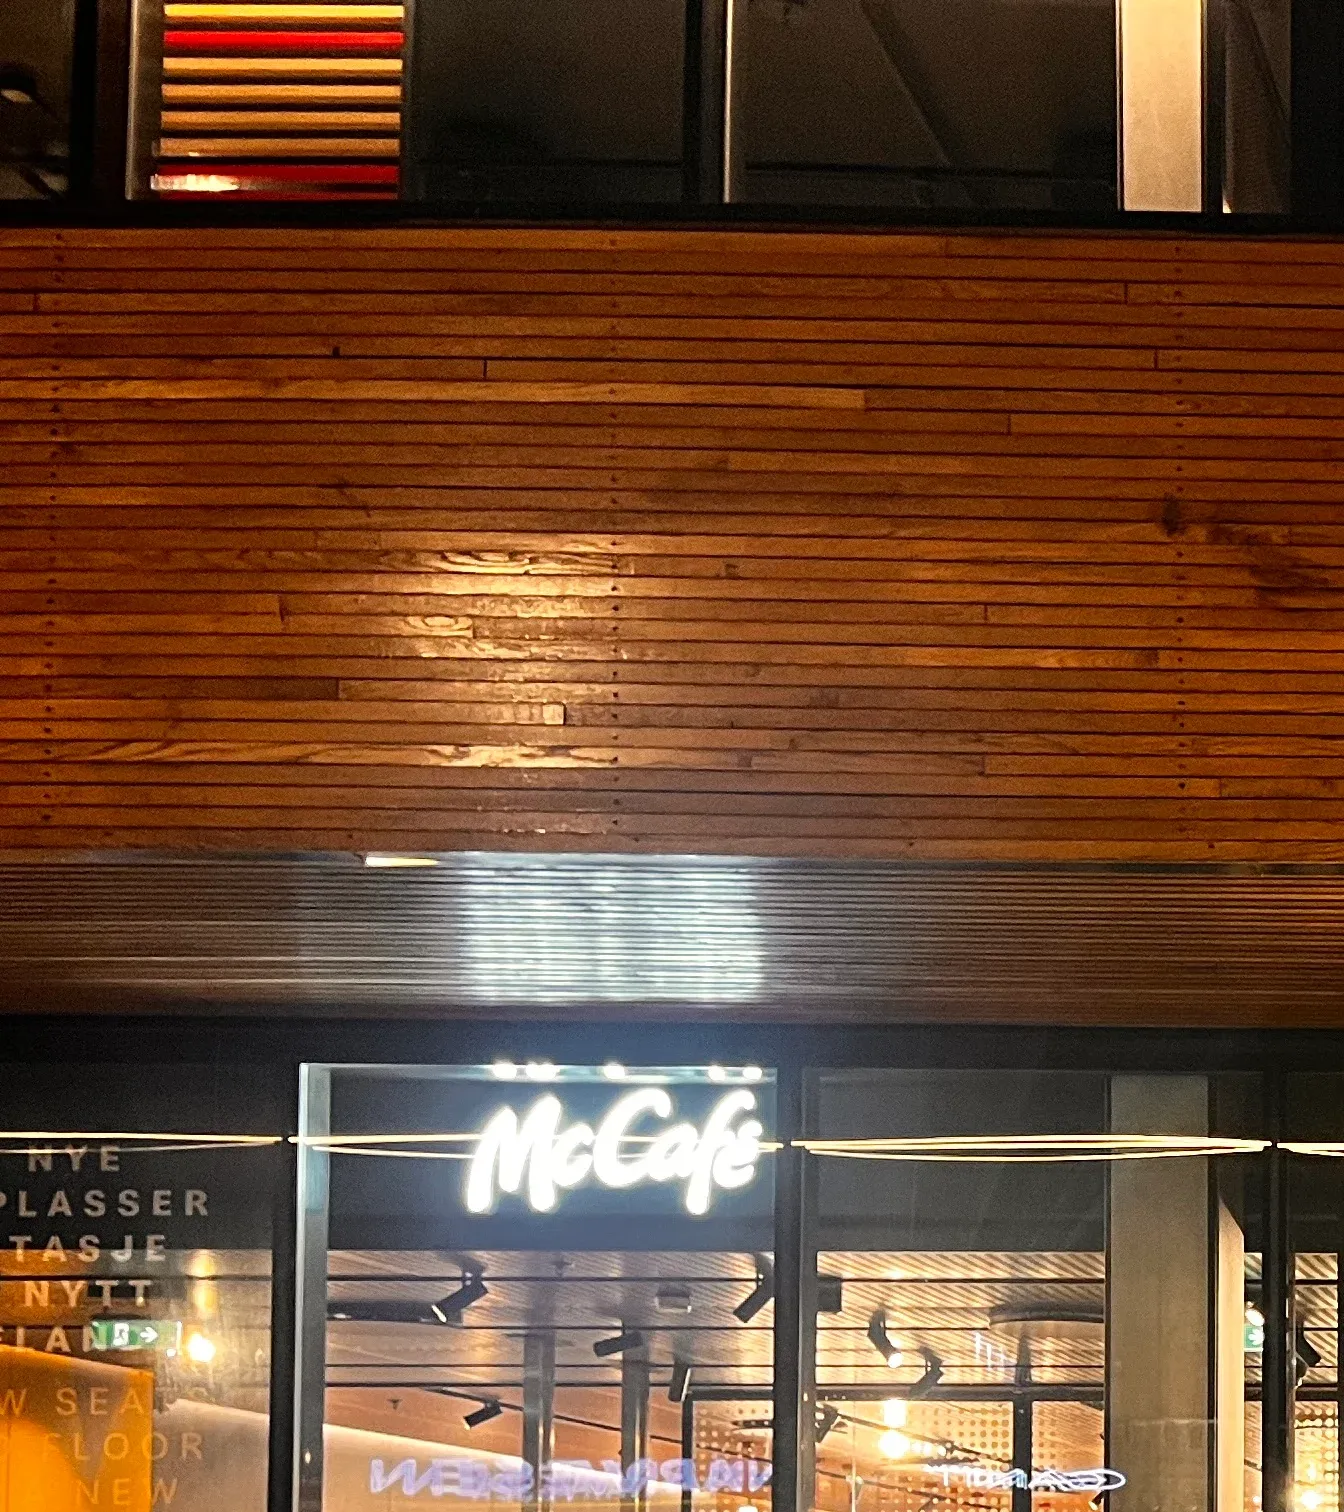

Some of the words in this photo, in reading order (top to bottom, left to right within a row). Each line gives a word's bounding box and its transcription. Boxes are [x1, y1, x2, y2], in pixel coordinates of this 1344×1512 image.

[28, 1142, 120, 1172] NYE
[0, 1189, 208, 1217] LASSER
[24, 1280, 153, 1307] NYTT
[43, 1432, 202, 1460] FLOOR
[76, 1478, 178, 1505] NEW
